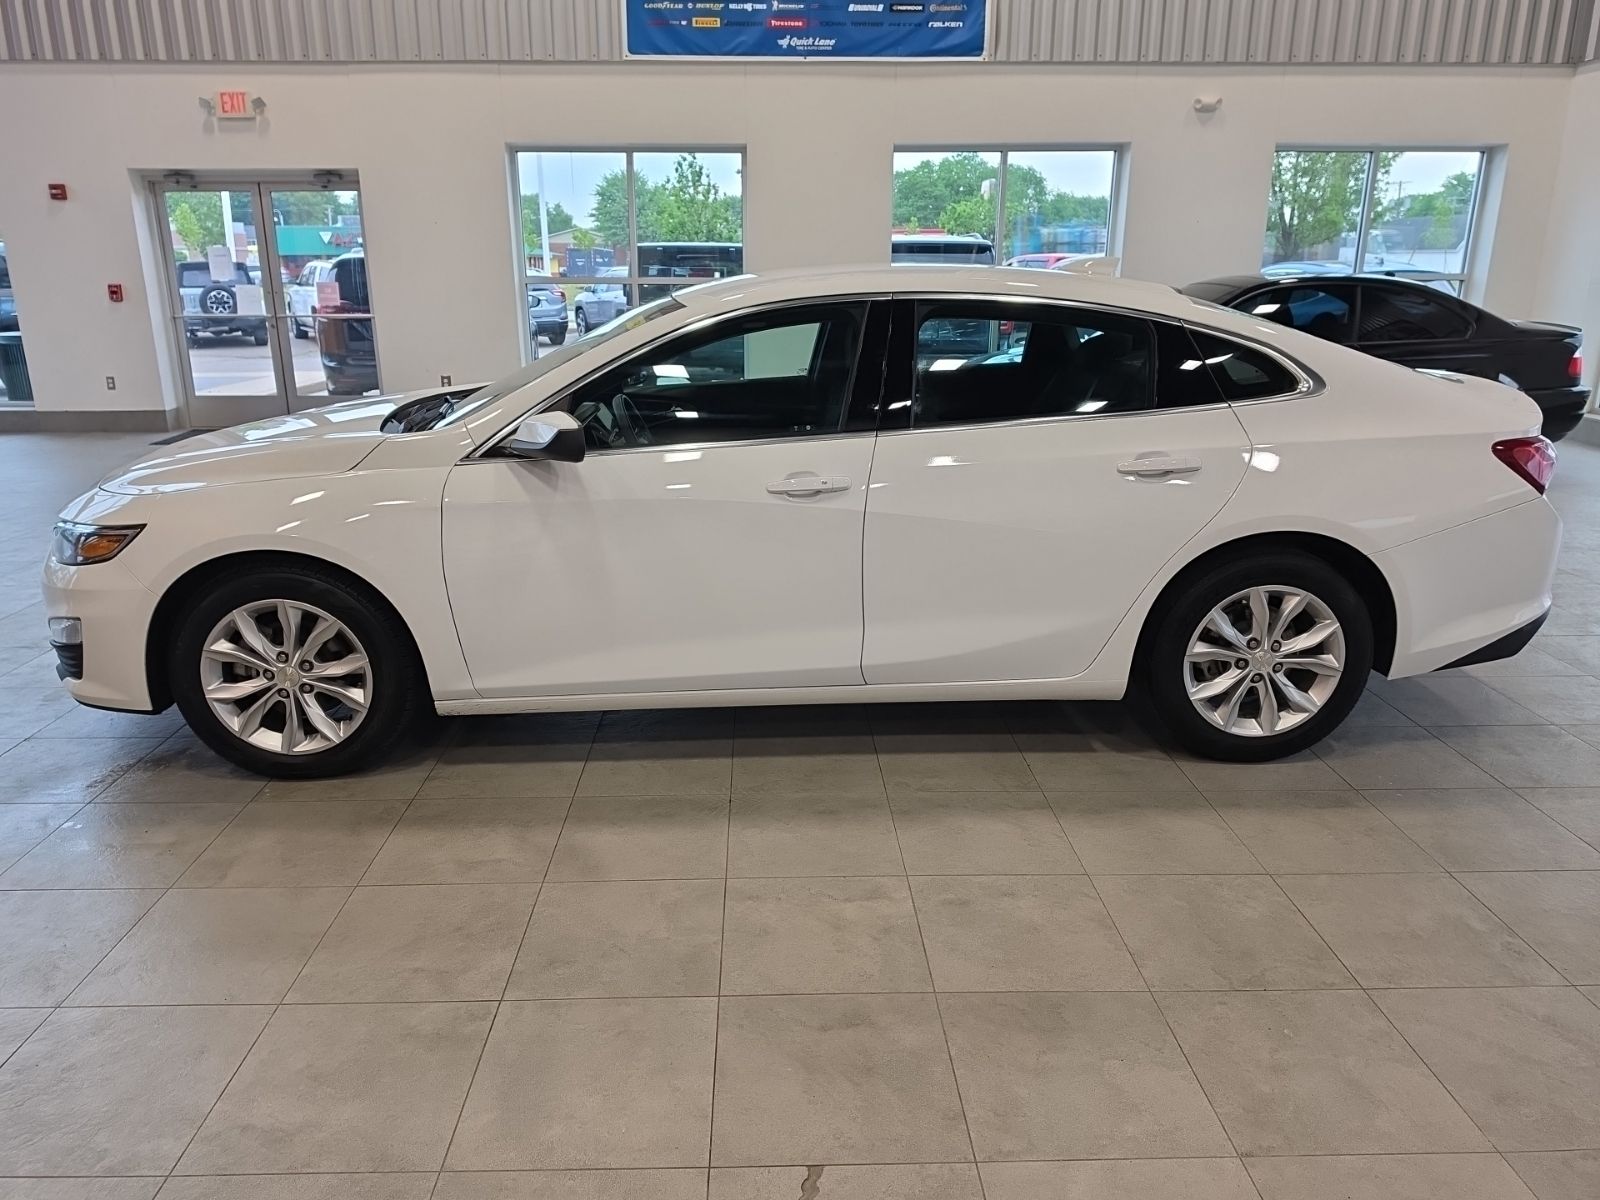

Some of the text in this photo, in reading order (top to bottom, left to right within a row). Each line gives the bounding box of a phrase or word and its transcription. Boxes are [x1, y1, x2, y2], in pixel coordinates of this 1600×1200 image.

[790, 37, 836, 47] Quick Lane
[220, 92, 246, 113] EXIT
